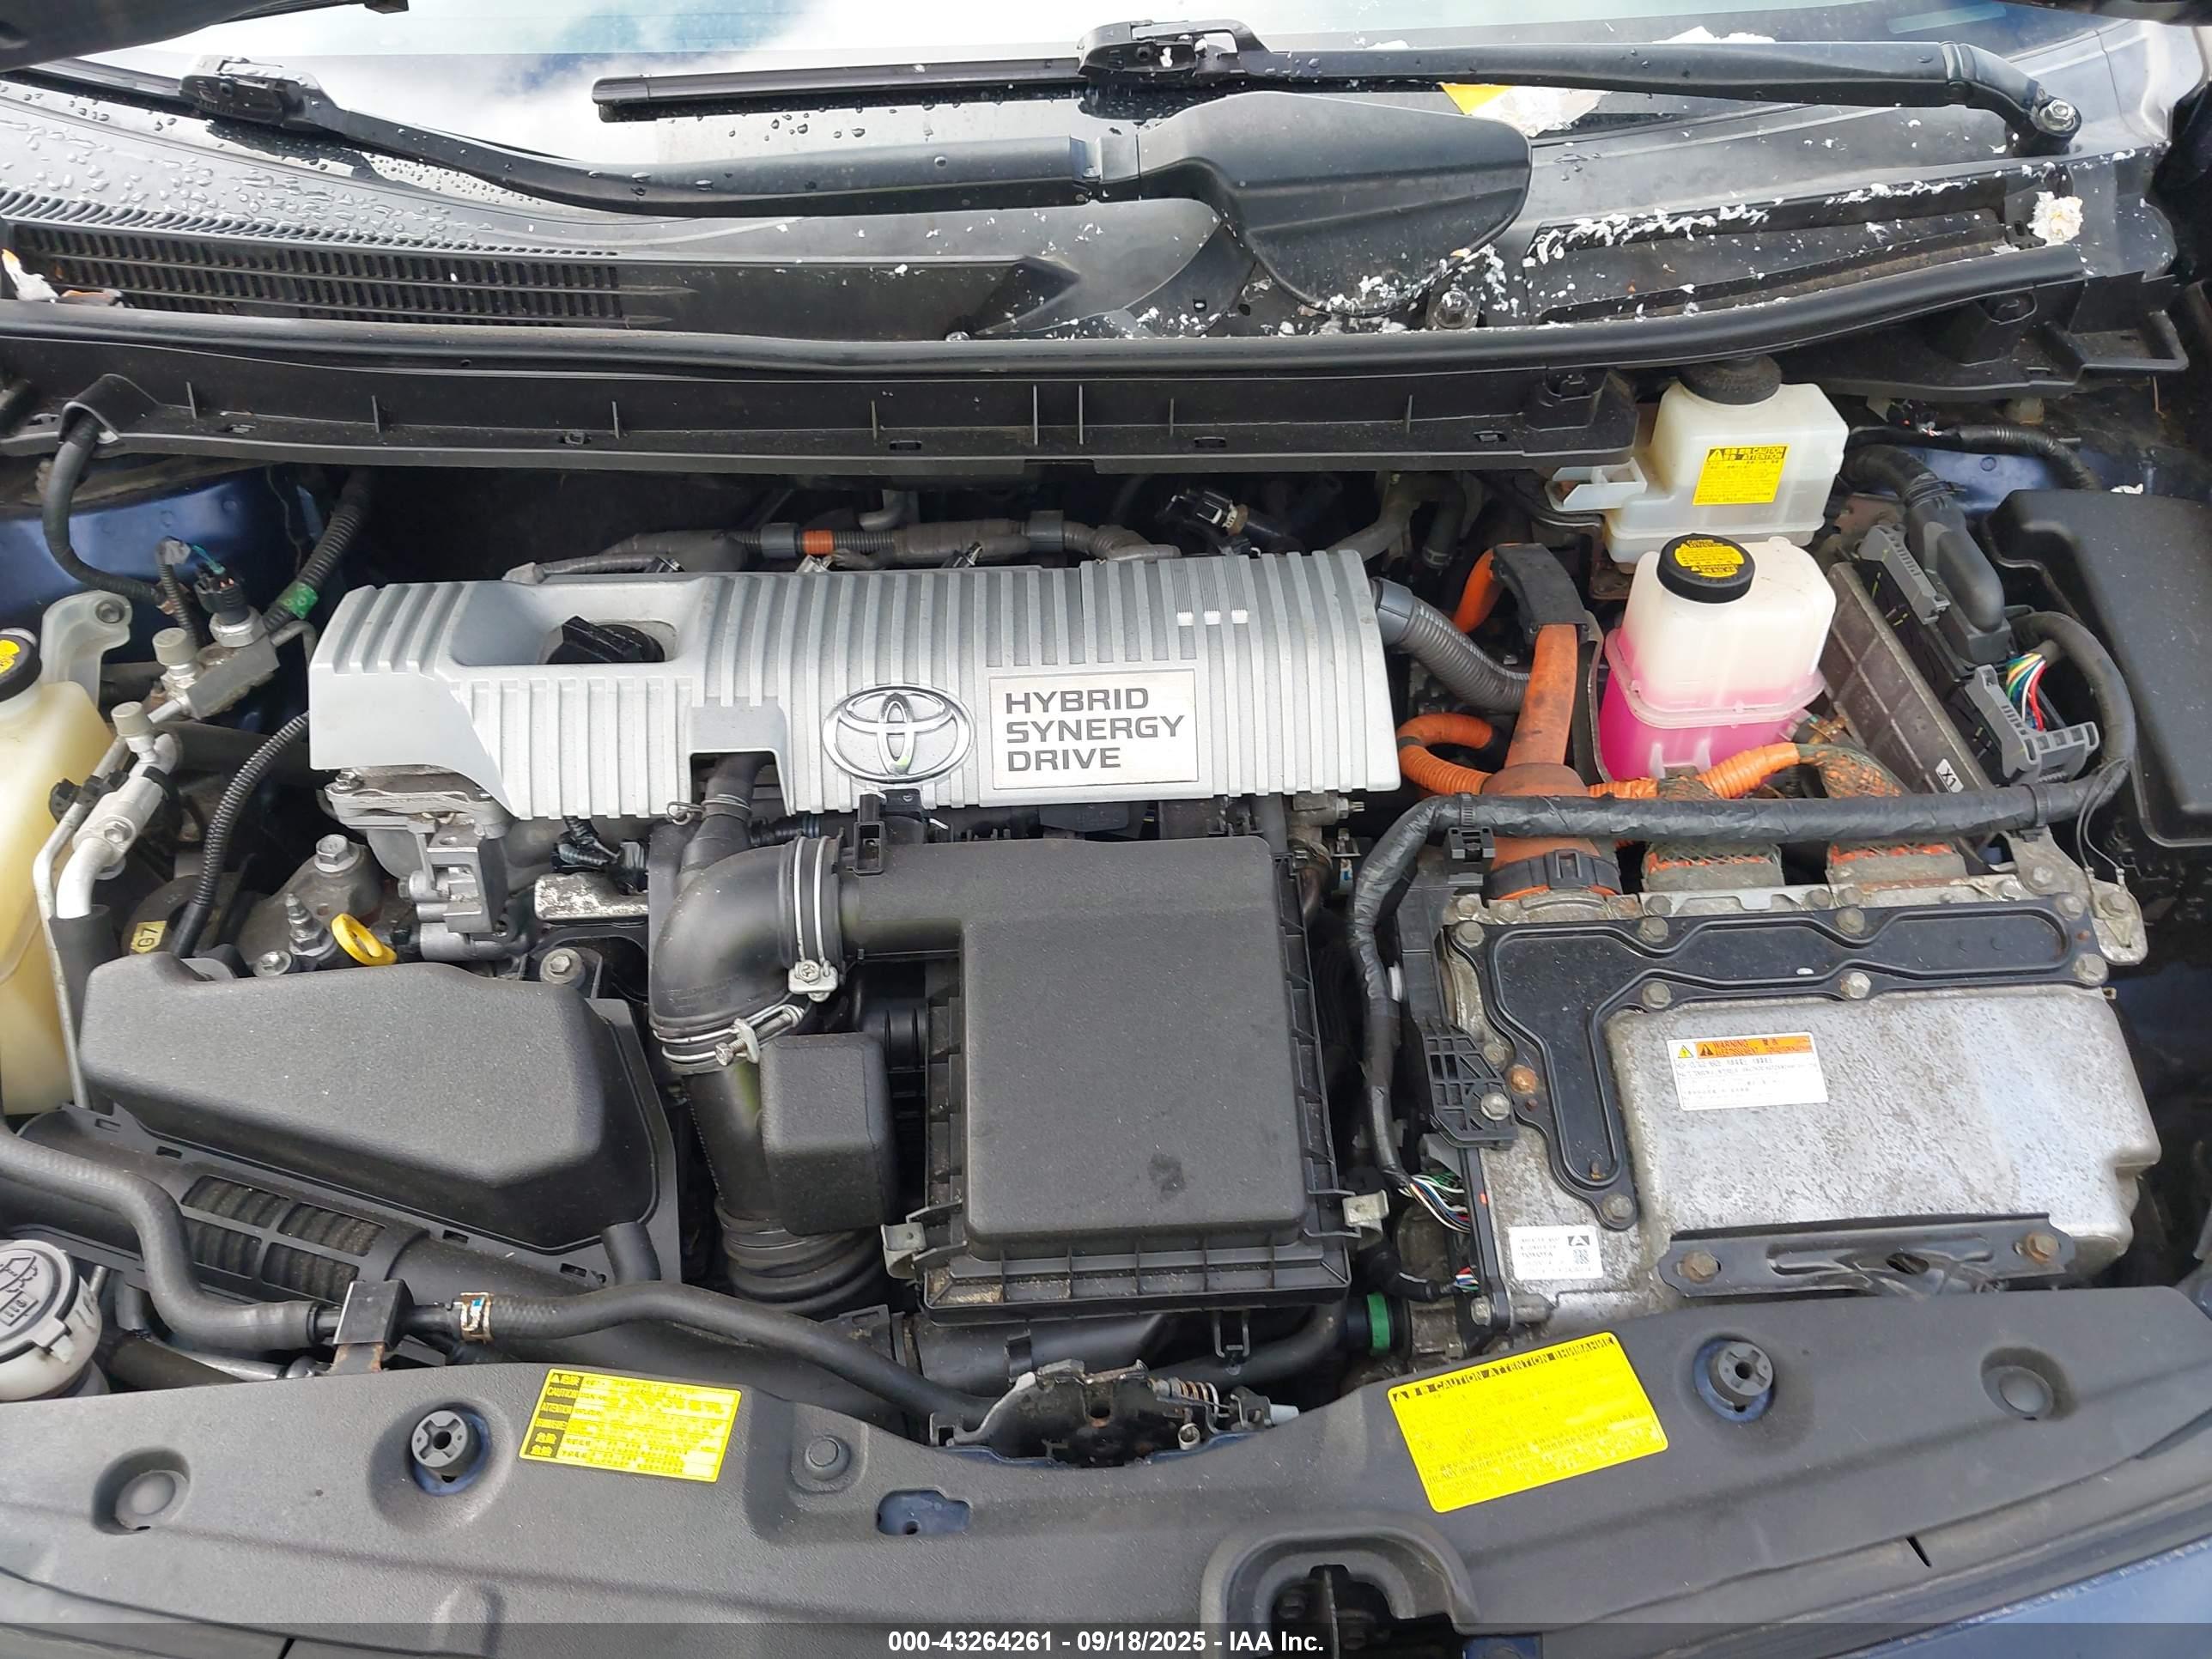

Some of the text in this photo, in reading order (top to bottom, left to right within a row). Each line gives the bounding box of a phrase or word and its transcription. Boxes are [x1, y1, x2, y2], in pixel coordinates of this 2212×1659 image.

[1006, 688, 1149, 714] HYBRID
[1006, 714, 1185, 744] SYNERGY
[1007, 747, 1121, 772] DRIVE
[1434, 1370, 1485, 1391] CAUTION
[1488, 1354, 1548, 1377] ATTENTION
